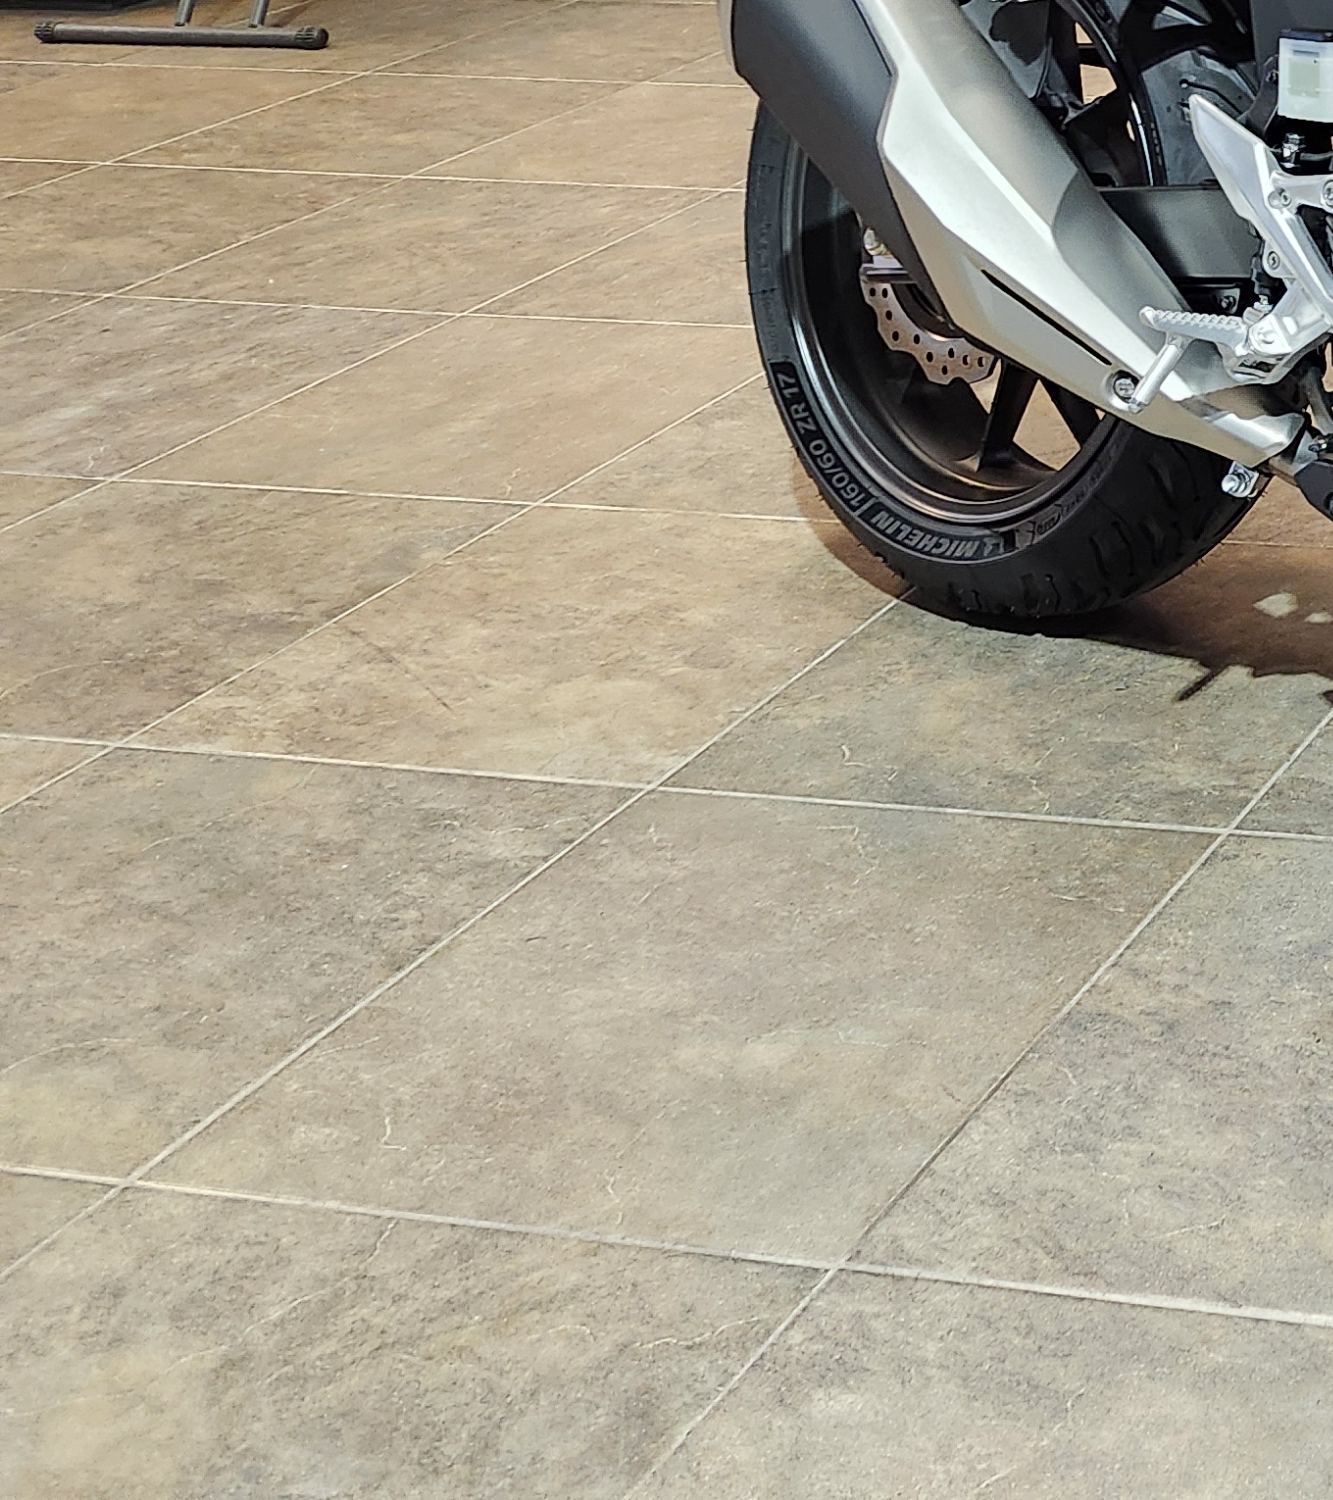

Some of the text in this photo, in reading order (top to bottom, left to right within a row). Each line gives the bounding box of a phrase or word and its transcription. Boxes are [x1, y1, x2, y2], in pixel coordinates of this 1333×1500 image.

[778, 373, 981, 558] MICHELIN 160/60 ZR 17
